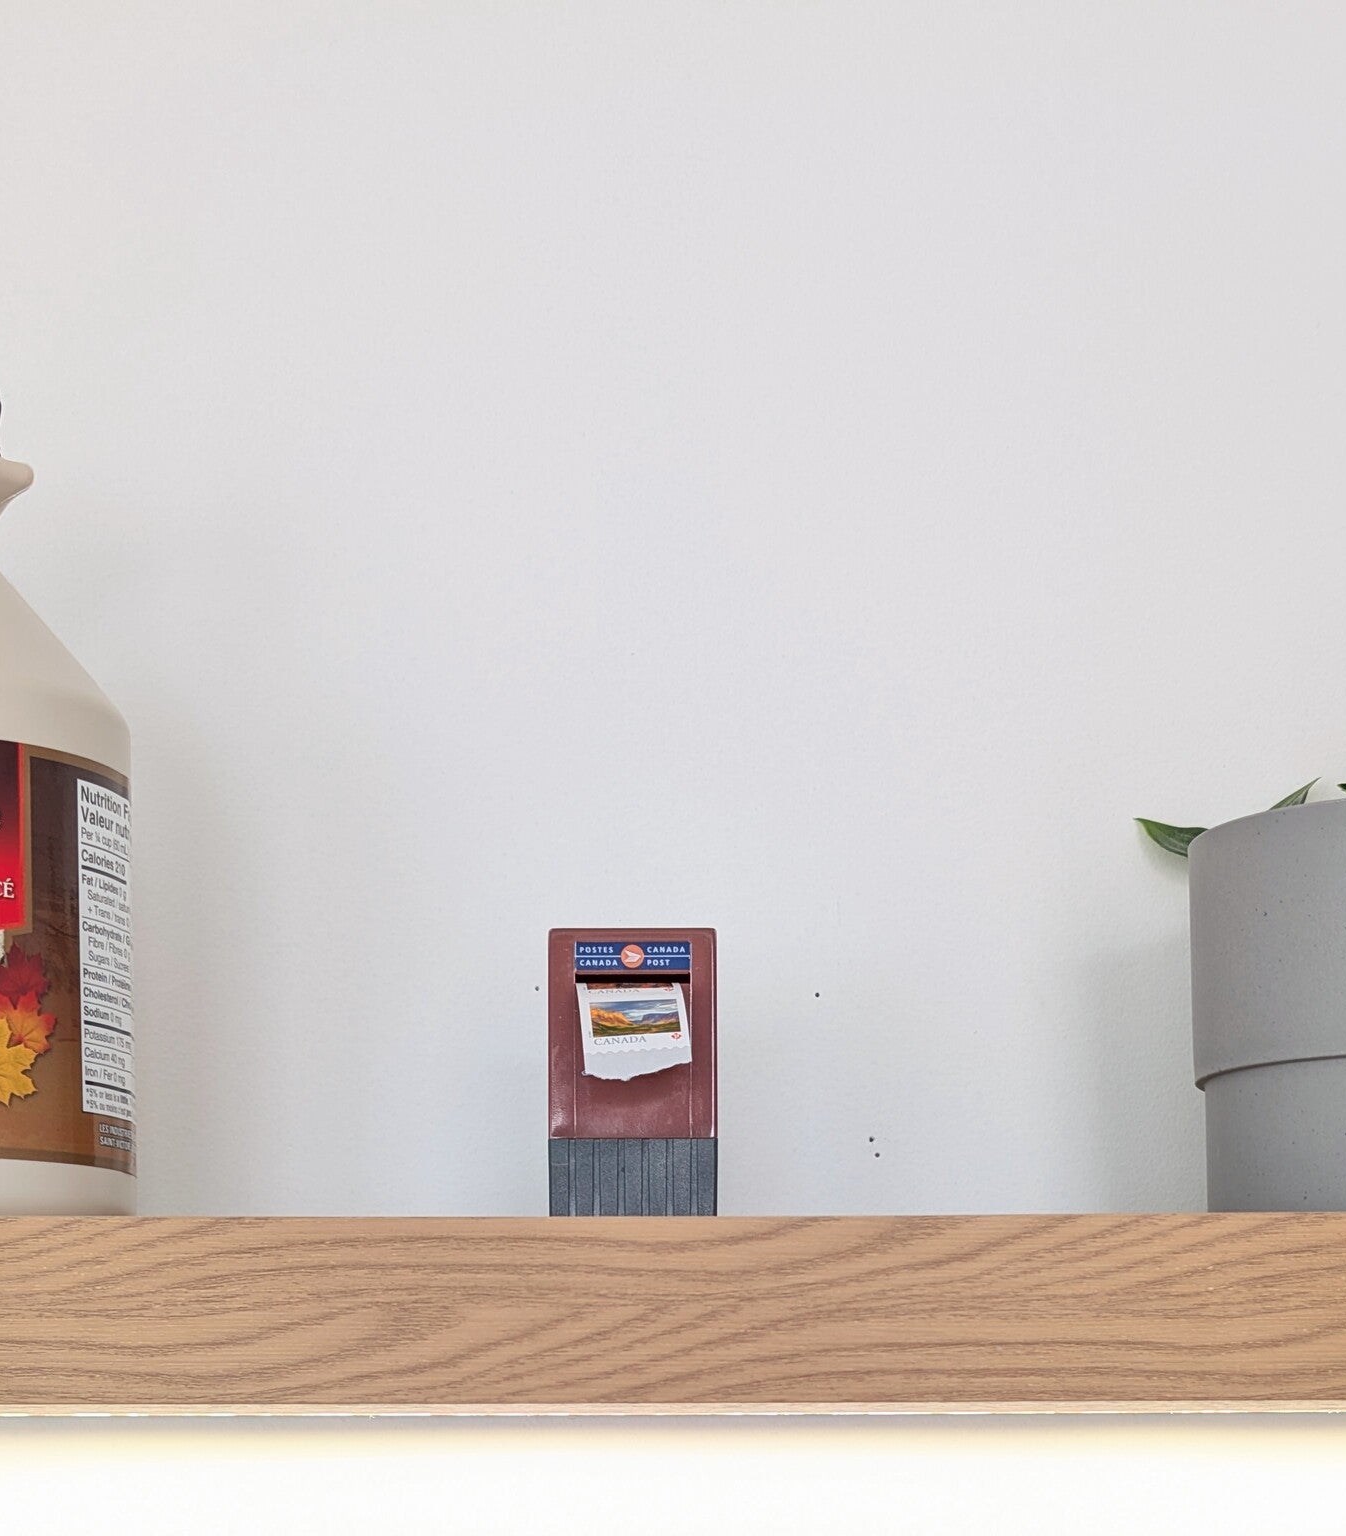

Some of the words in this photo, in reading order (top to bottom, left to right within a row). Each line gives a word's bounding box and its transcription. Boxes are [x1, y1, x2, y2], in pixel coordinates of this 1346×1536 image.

[81, 785, 121, 816] Nutrition
[81, 805, 113, 832] Valeur
[81, 849, 114, 871] Calories
[82, 874, 94, 887] Fat
[579, 946, 614, 954] POSTES
[646, 946, 686, 954] CANADA
[579, 959, 618, 967] CANADA
[647, 959, 670, 967] POST
[83, 967, 108, 983] Protein
[83, 1005, 110, 1021] Sodium
[84, 1028, 115, 1045] Potassium
[594, 1035, 647, 1046] CANADA
[84, 1046, 110, 1062] Calcium
[85, 1065, 99, 1078] Iron
